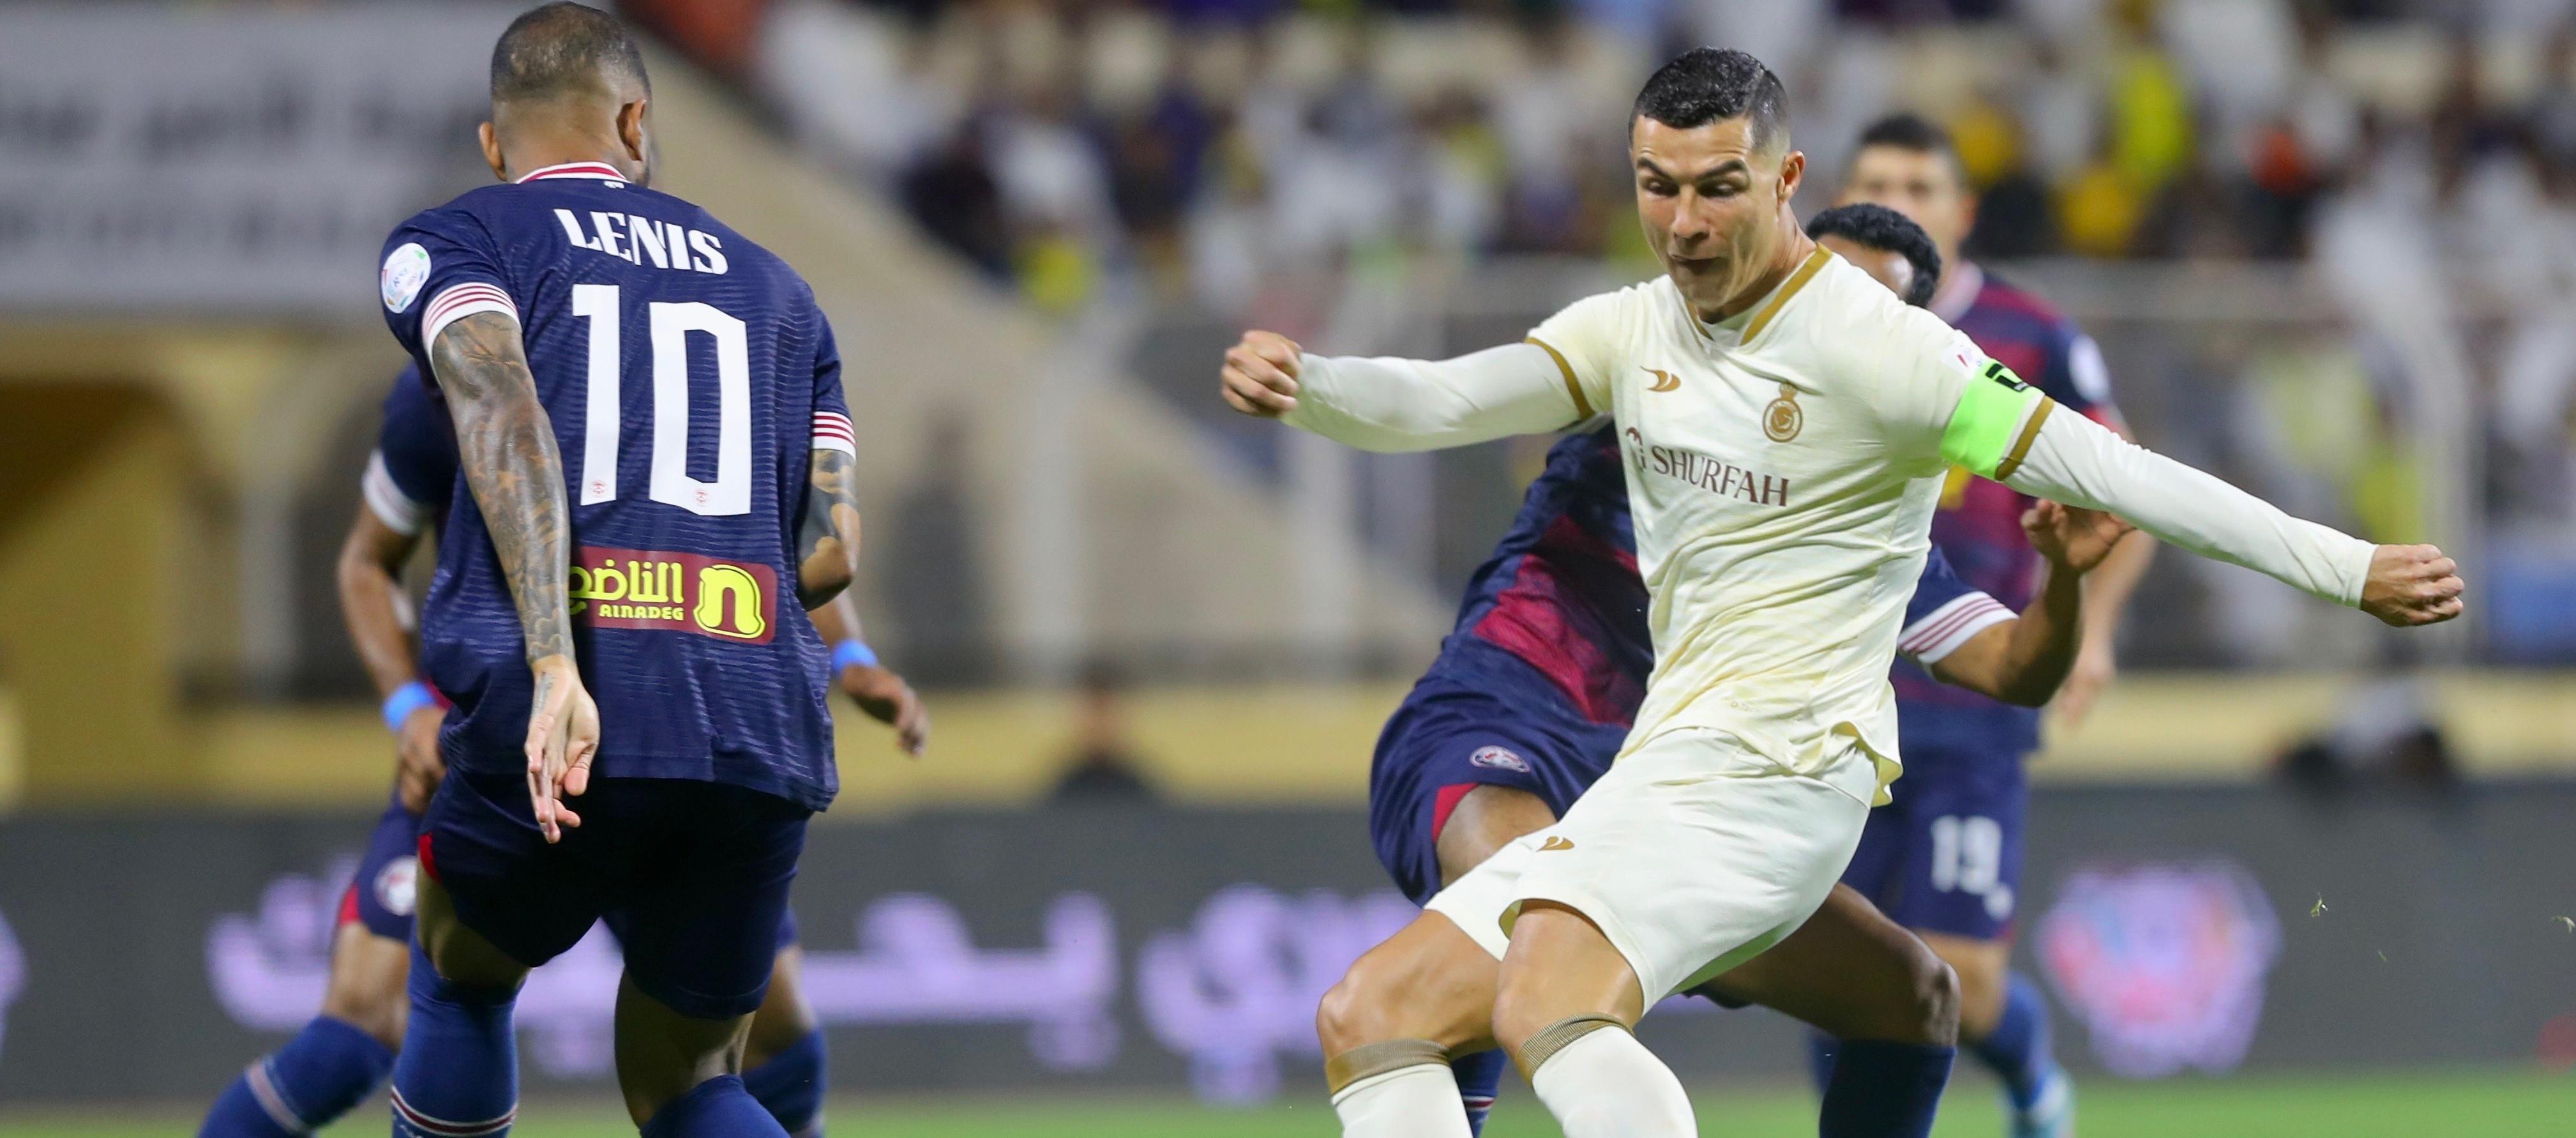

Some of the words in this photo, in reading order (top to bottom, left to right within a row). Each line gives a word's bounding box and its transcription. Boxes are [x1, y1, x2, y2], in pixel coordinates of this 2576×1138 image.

[553, 208, 728, 275] LENIS
[572, 284, 752, 516] 10
[1651, 444, 1790, 506] SHURFAH
